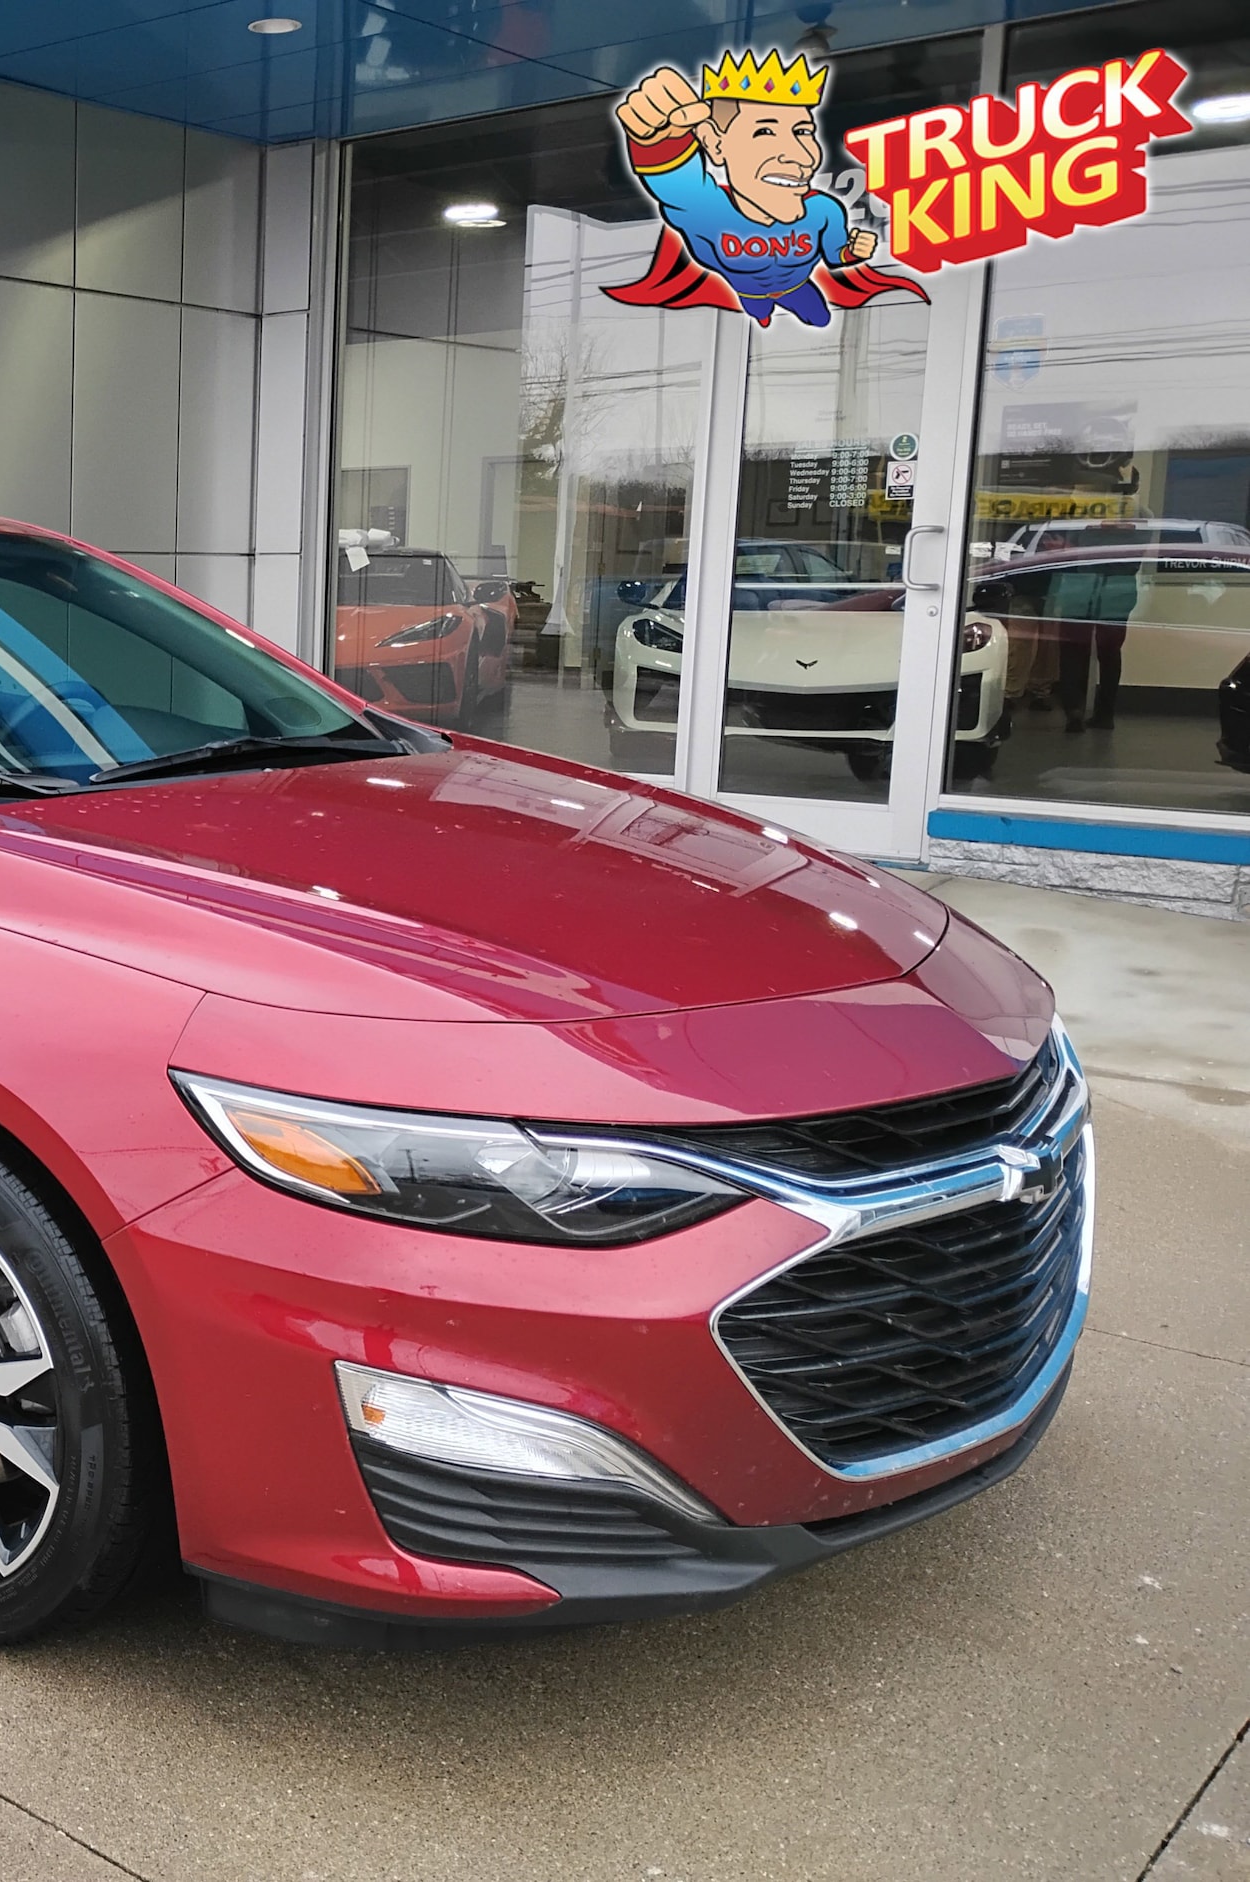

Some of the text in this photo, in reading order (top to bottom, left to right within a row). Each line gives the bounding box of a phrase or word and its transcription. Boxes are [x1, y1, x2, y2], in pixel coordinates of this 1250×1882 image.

[790, 453, 819, 461] Monday
[790, 461, 818, 469] Tuesday
[790, 468, 830, 476] Wednesday
[789, 477, 821, 485] Thursday
[788, 485, 810, 493] Friday
[787, 499, 865, 509] Sunday CLOSED
[1163, 556, 1250, 569] TREVOR SHIPM
